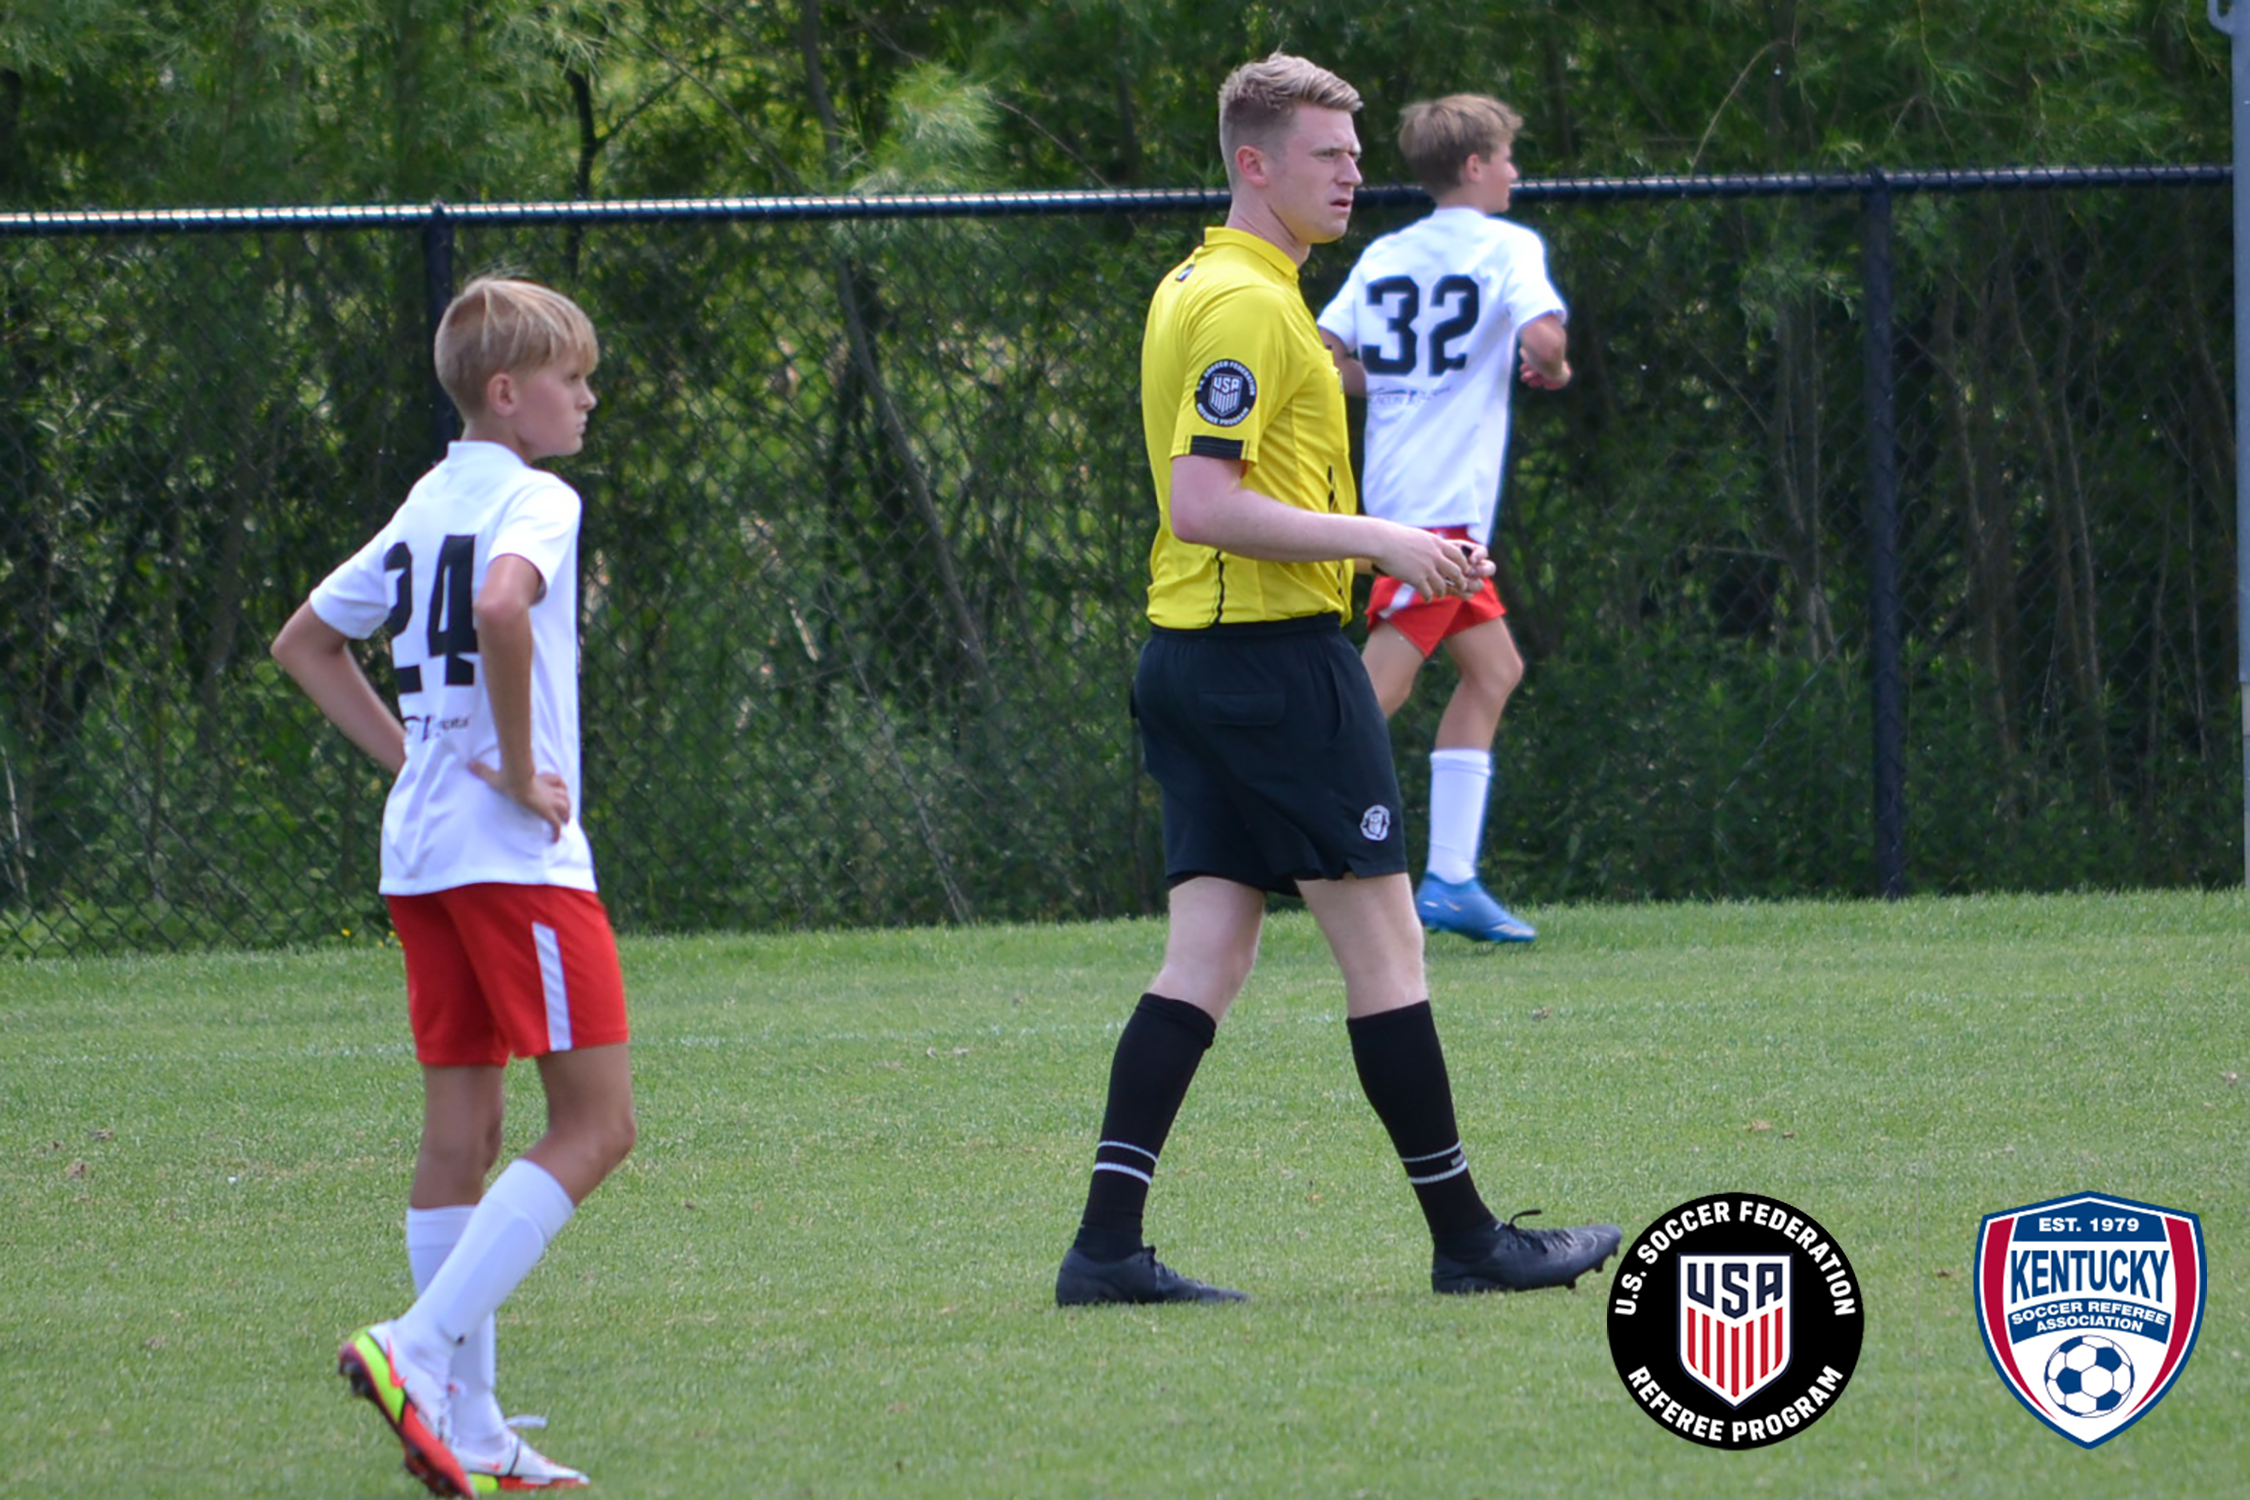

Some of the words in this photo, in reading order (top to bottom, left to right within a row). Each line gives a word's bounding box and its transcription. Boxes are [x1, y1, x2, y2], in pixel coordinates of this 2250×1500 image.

[1361, 274, 1480, 377] 32
[1213, 376, 1240, 393] USA
[384, 534, 479, 694] 24
